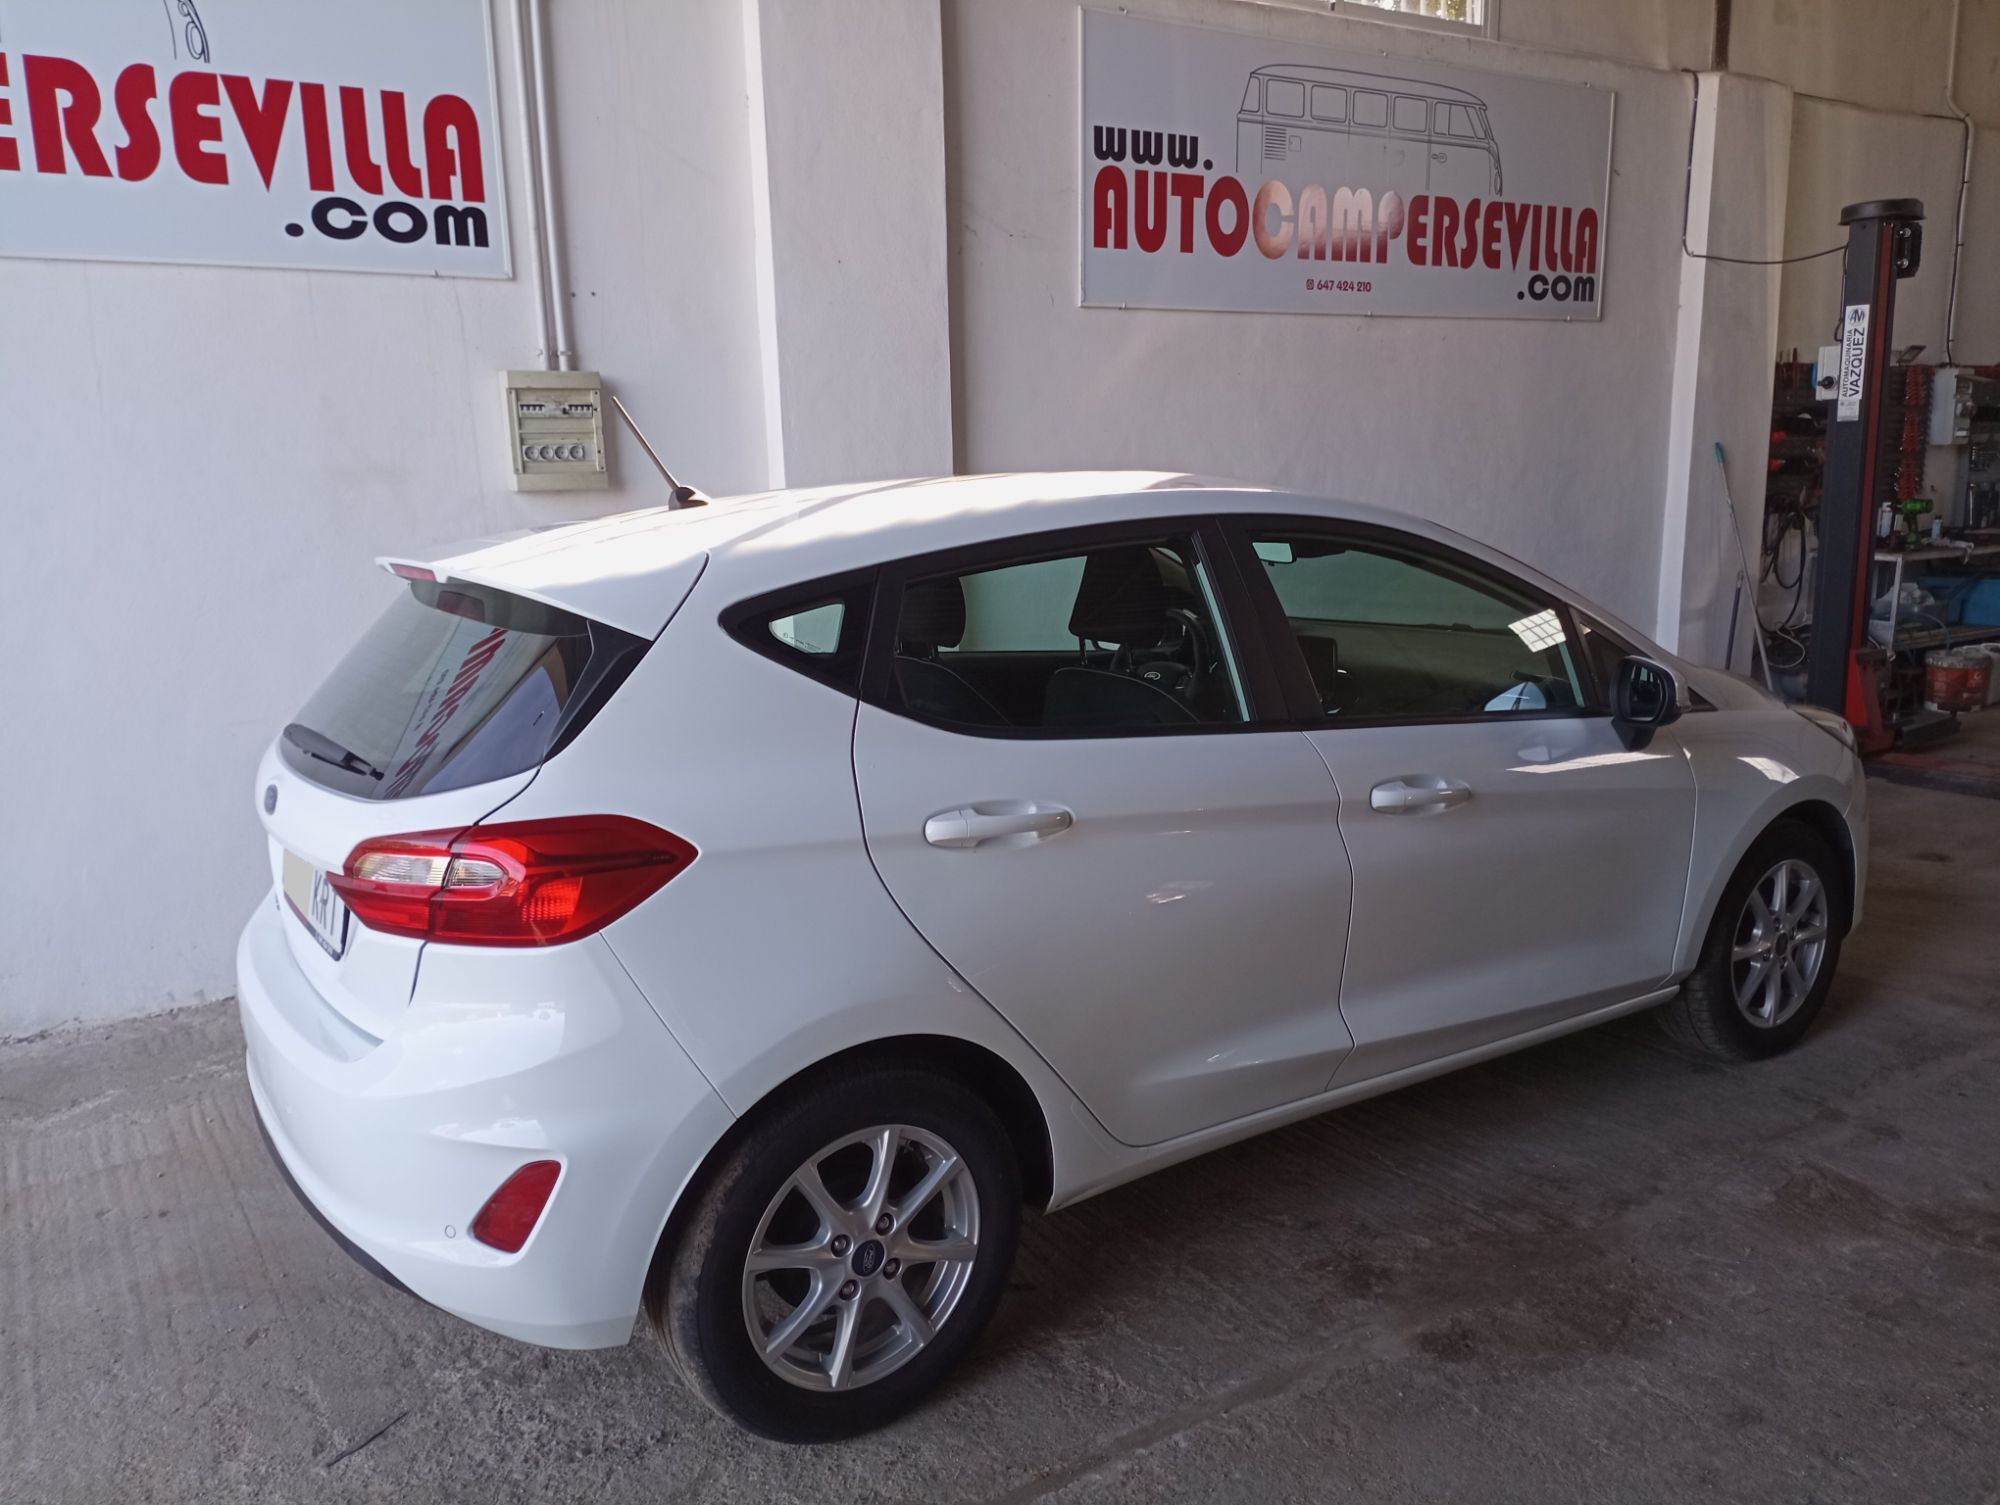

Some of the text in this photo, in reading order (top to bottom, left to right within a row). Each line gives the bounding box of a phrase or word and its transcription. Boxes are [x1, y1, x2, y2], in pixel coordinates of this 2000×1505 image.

[1093, 165, 1598, 273] AUTOCAMPERSEVILLA
[1317, 280, 1372, 292] 647 424 210
[1842, 329, 1853, 398] AUTOMAQUINARIA
[1848, 327, 1865, 398] VAZQUEZ
